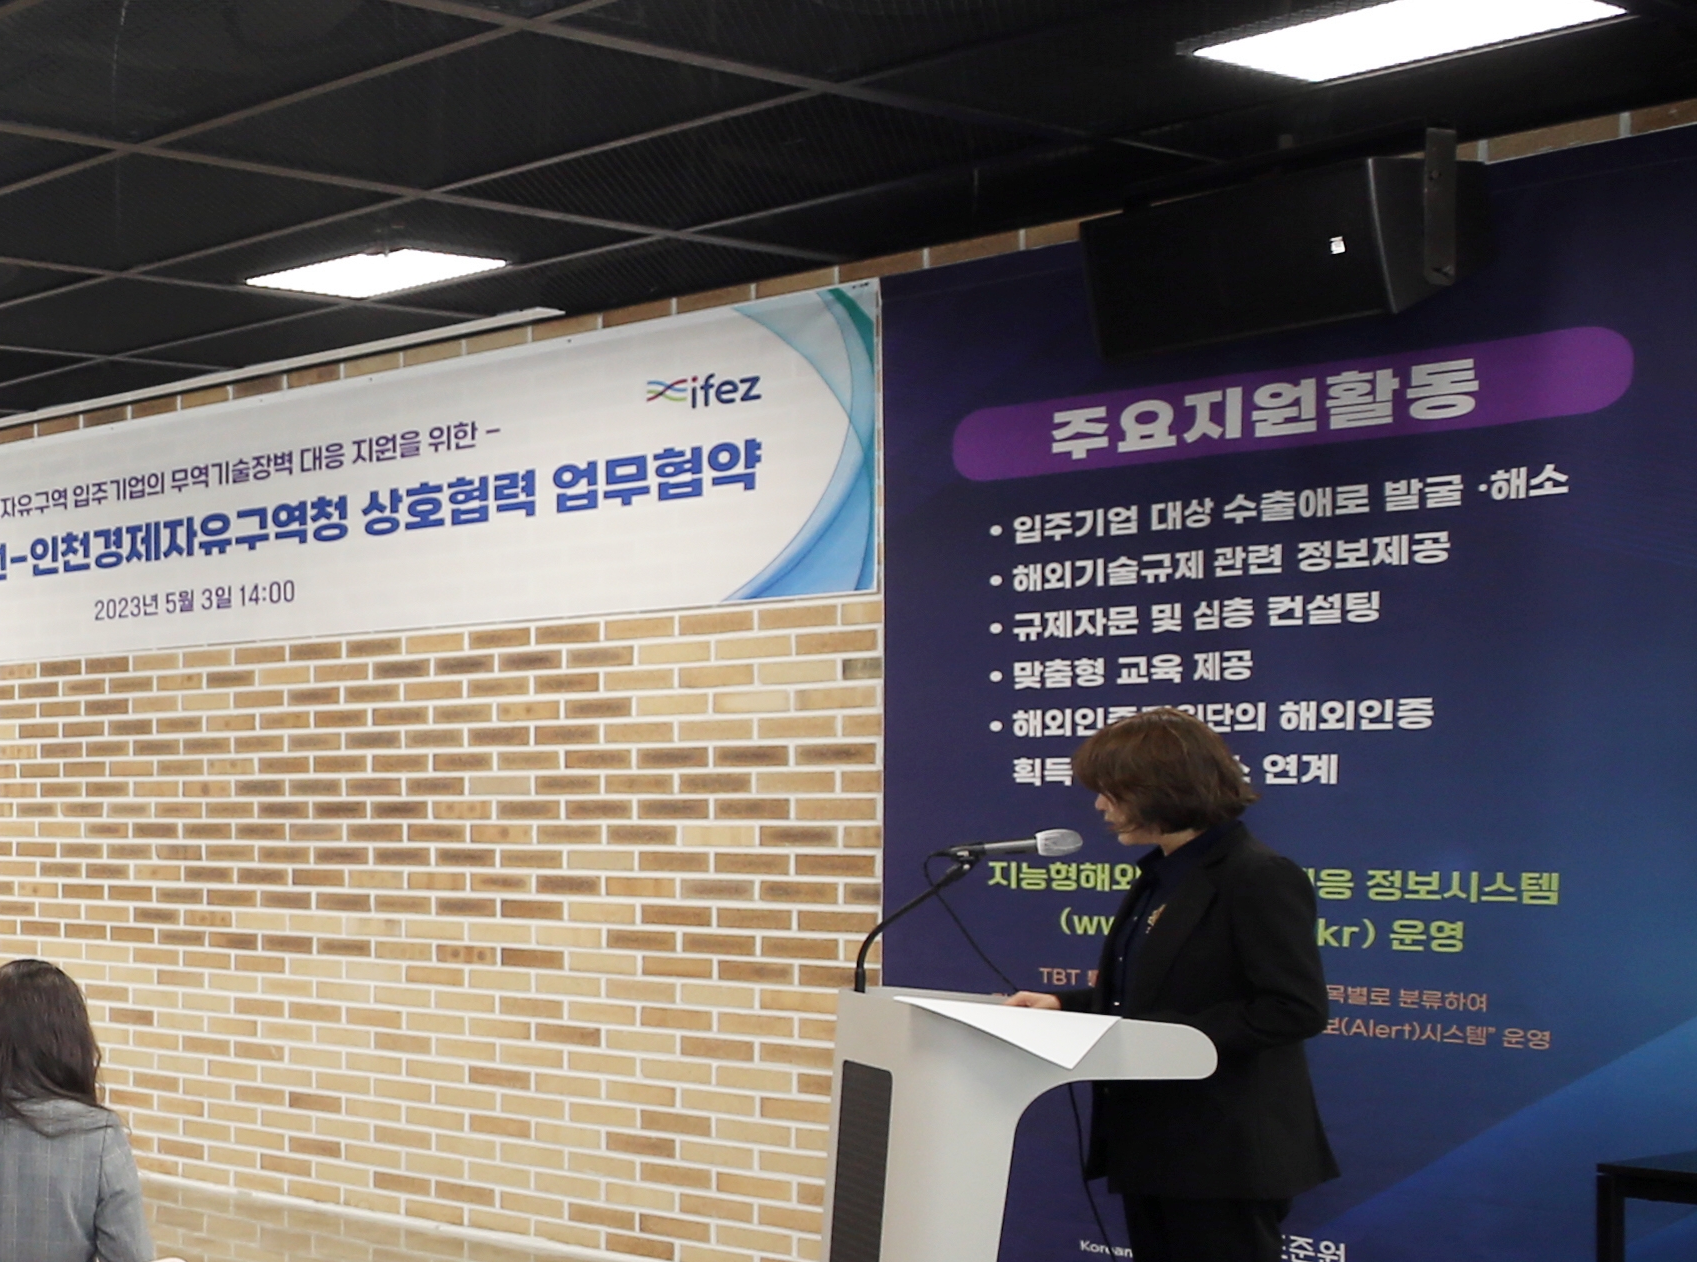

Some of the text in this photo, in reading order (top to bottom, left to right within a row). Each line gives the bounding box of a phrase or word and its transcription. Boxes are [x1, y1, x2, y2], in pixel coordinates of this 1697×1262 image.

[690, 373, 762, 409] ifez
[1050, 358, 1480, 461] 주요지원활동
[72, 472, 165, 509] 입주기업의
[171, 450, 295, 493] 무역기술장벽
[299, 442, 345, 474] 대응
[351, 429, 422, 465] 지원을
[428, 421, 479, 453] 위한
[361, 468, 537, 538] 상호협력
[552, 438, 763, 514] 업무협약
[1013, 504, 1138, 545] 입주기업
[1150, 498, 1213, 533] 대상
[1223, 483, 1370, 526] 수출애로
[1384, 474, 1463, 513] 발굴
[1013, 531, 1451, 594] 해외기술규제 관련 정보제공
[94, 579, 296, 622] 2023년 5월 3일 14:00
[1012, 590, 1381, 641] 규제자문 및 심층 컨설팅
[1013, 649, 1253, 690] 맞춤형 교육 제공
[1279, 697, 1435, 732] 해외인증
[1013, 757, 1074, 787] 획득
[1263, 753, 1339, 786] 연계
[1366, 868, 1560, 905] 정보시스템
[1390, 919, 1464, 952] 운영
[1039, 967, 1081, 986] TBT
[1398, 988, 1487, 1013] 분류하여
[1502, 1027, 1551, 1050] 운영
